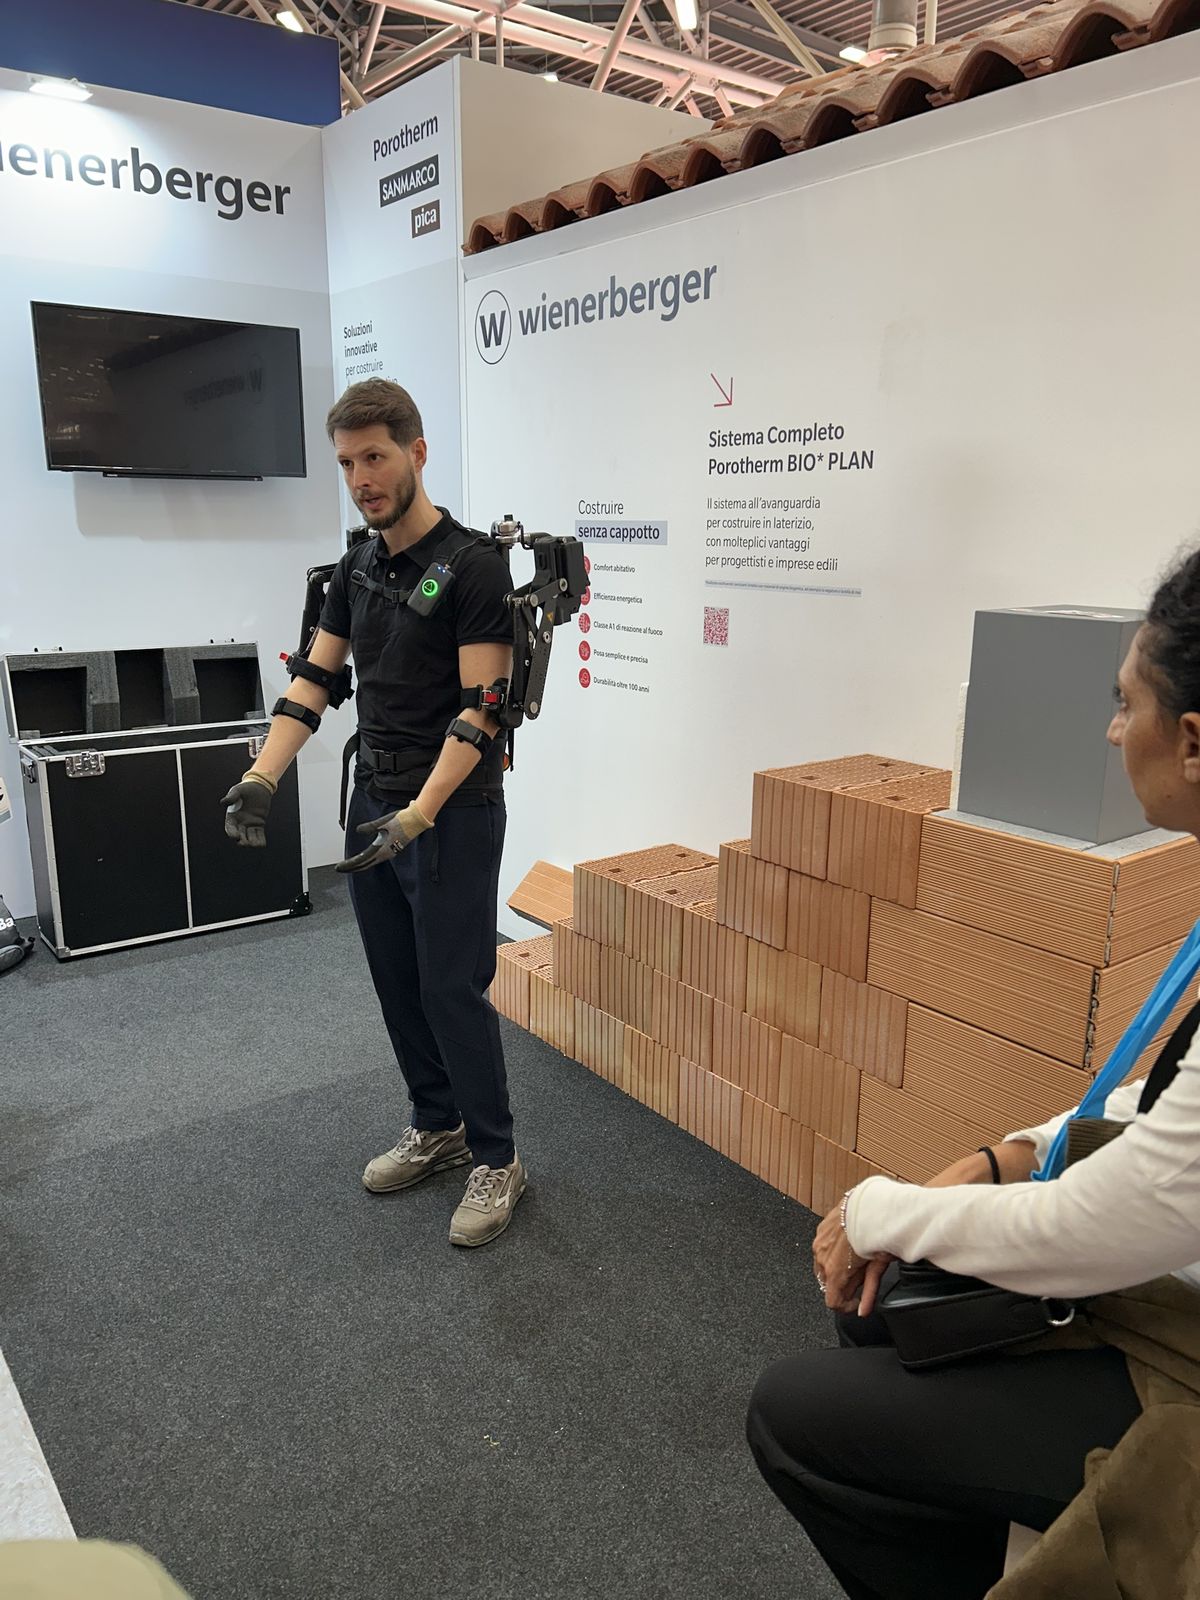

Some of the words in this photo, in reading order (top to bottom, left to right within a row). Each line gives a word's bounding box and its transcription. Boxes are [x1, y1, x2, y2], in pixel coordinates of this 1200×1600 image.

[373, 115, 438, 162] Porotherm
[382, 163, 436, 201] SANMARCO
[414, 208, 437, 234] pica
[518, 265, 717, 336] wienerberger
[343, 320, 373, 339] Soluzioni
[344, 340, 378, 358] innovative
[345, 366, 355, 379] per
[356, 358, 384, 375] costruire
[709, 430, 764, 448] Sistema
[767, 422, 845, 446] Completo
[708, 456, 783, 475] Porotherm
[828, 450, 874, 471] PLAN
[578, 499, 624, 515] Costruire
[714, 498, 747, 509] sistema
[748, 496, 821, 512] all'avanguardia
[706, 519, 720, 530] per
[722, 517, 761, 529] costruire
[763, 517, 772, 529] in
[773, 517, 815, 531] laterizio,
[578, 526, 607, 538] senza
[609, 525, 660, 542] cappotto
[705, 537, 721, 547] con
[723, 536, 767, 550] molteplici
[768, 537, 811, 552] vantaggi
[593, 563, 613, 572] Comfort
[613, 564, 636, 573] abitativo
[705, 556, 719, 567] per
[721, 555, 767, 569] progettisti
[768, 558, 774, 568] e
[775, 556, 815, 571] imprese
[816, 558, 838, 571] edili
[593, 592, 616, 601] Efficienza
[616, 595, 643, 604] energetica
[593, 620, 609, 629] Classe
[621, 625, 642, 633] reazione
[648, 627, 664, 636] fuoco
[593, 649, 605, 658] Posa
[605, 652, 626, 661] semplice
[630, 655, 649, 664] precisa
[616, 681, 628, 690] oltre
[628, 683, 638, 691] 100
[638, 685, 650, 693] anni
